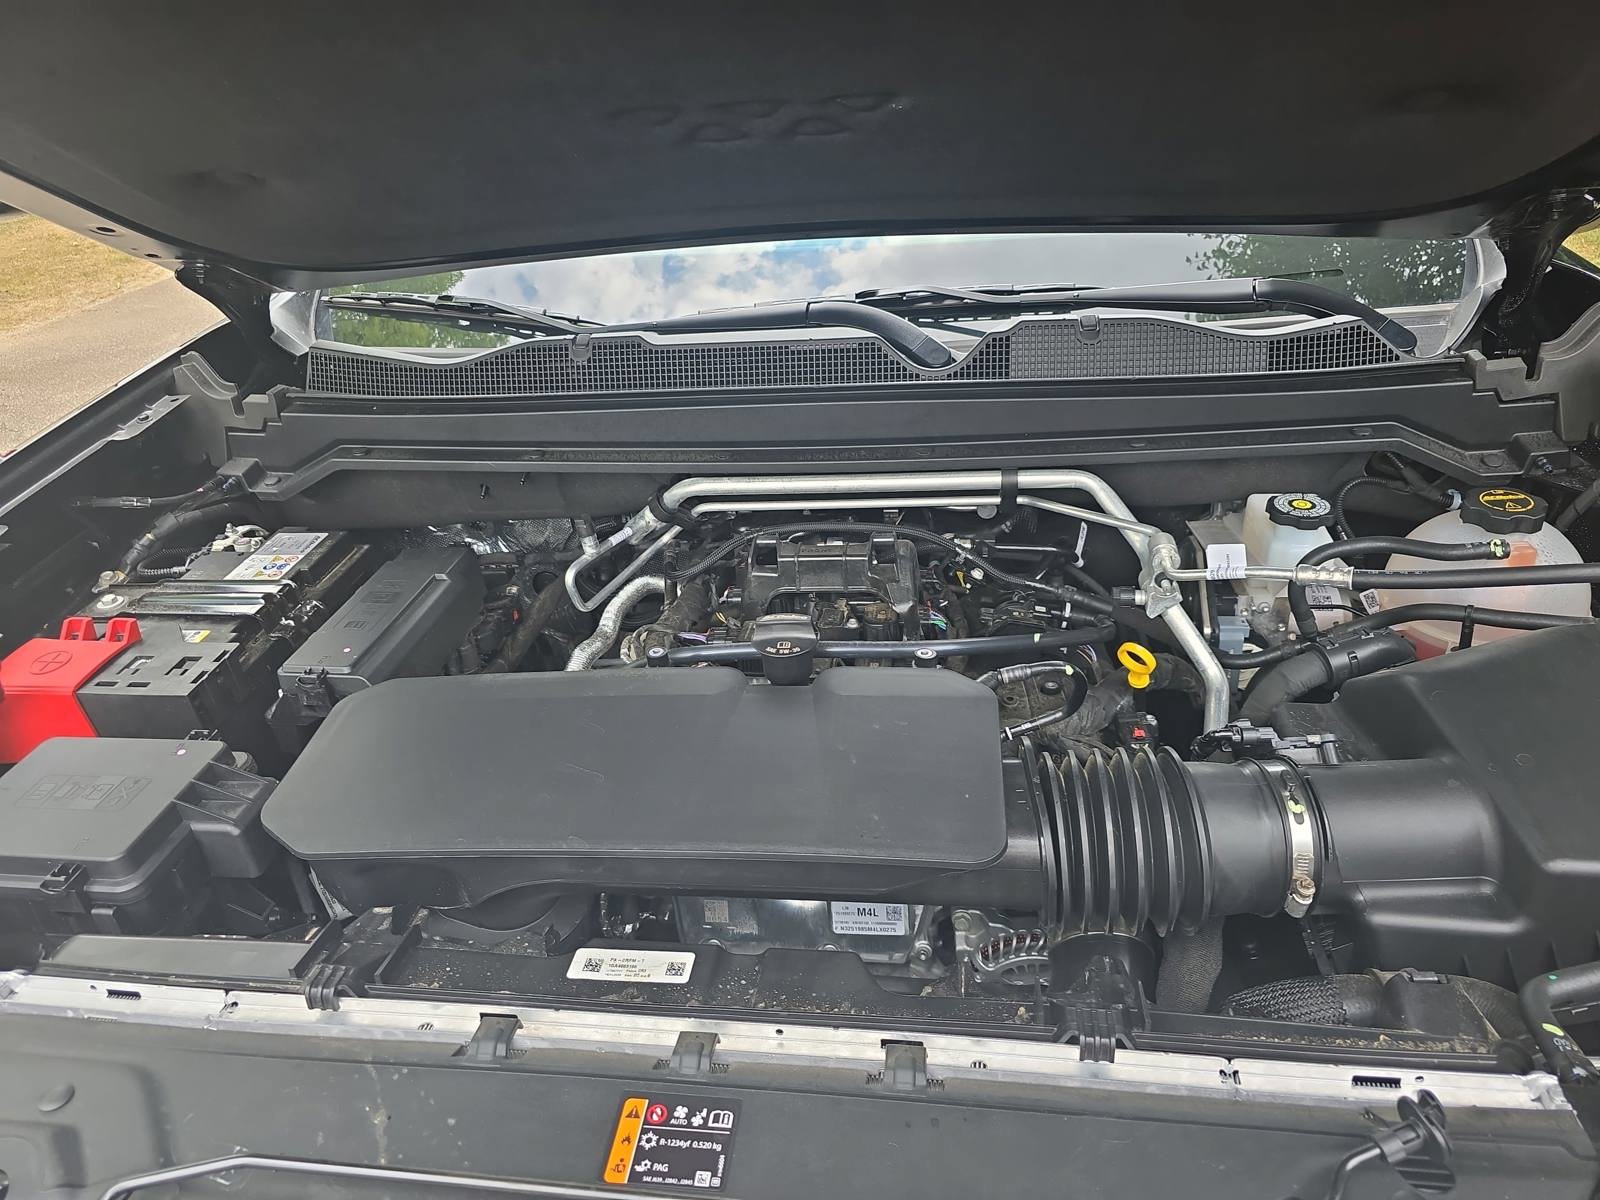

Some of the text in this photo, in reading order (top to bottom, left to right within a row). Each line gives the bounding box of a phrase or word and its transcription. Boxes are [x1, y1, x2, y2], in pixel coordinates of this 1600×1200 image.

[857, 907, 879, 917] M4L
[659, 1138, 722, 1151] R-1234yf 0.520 kg
[652, 1163, 669, 1172] PAG
